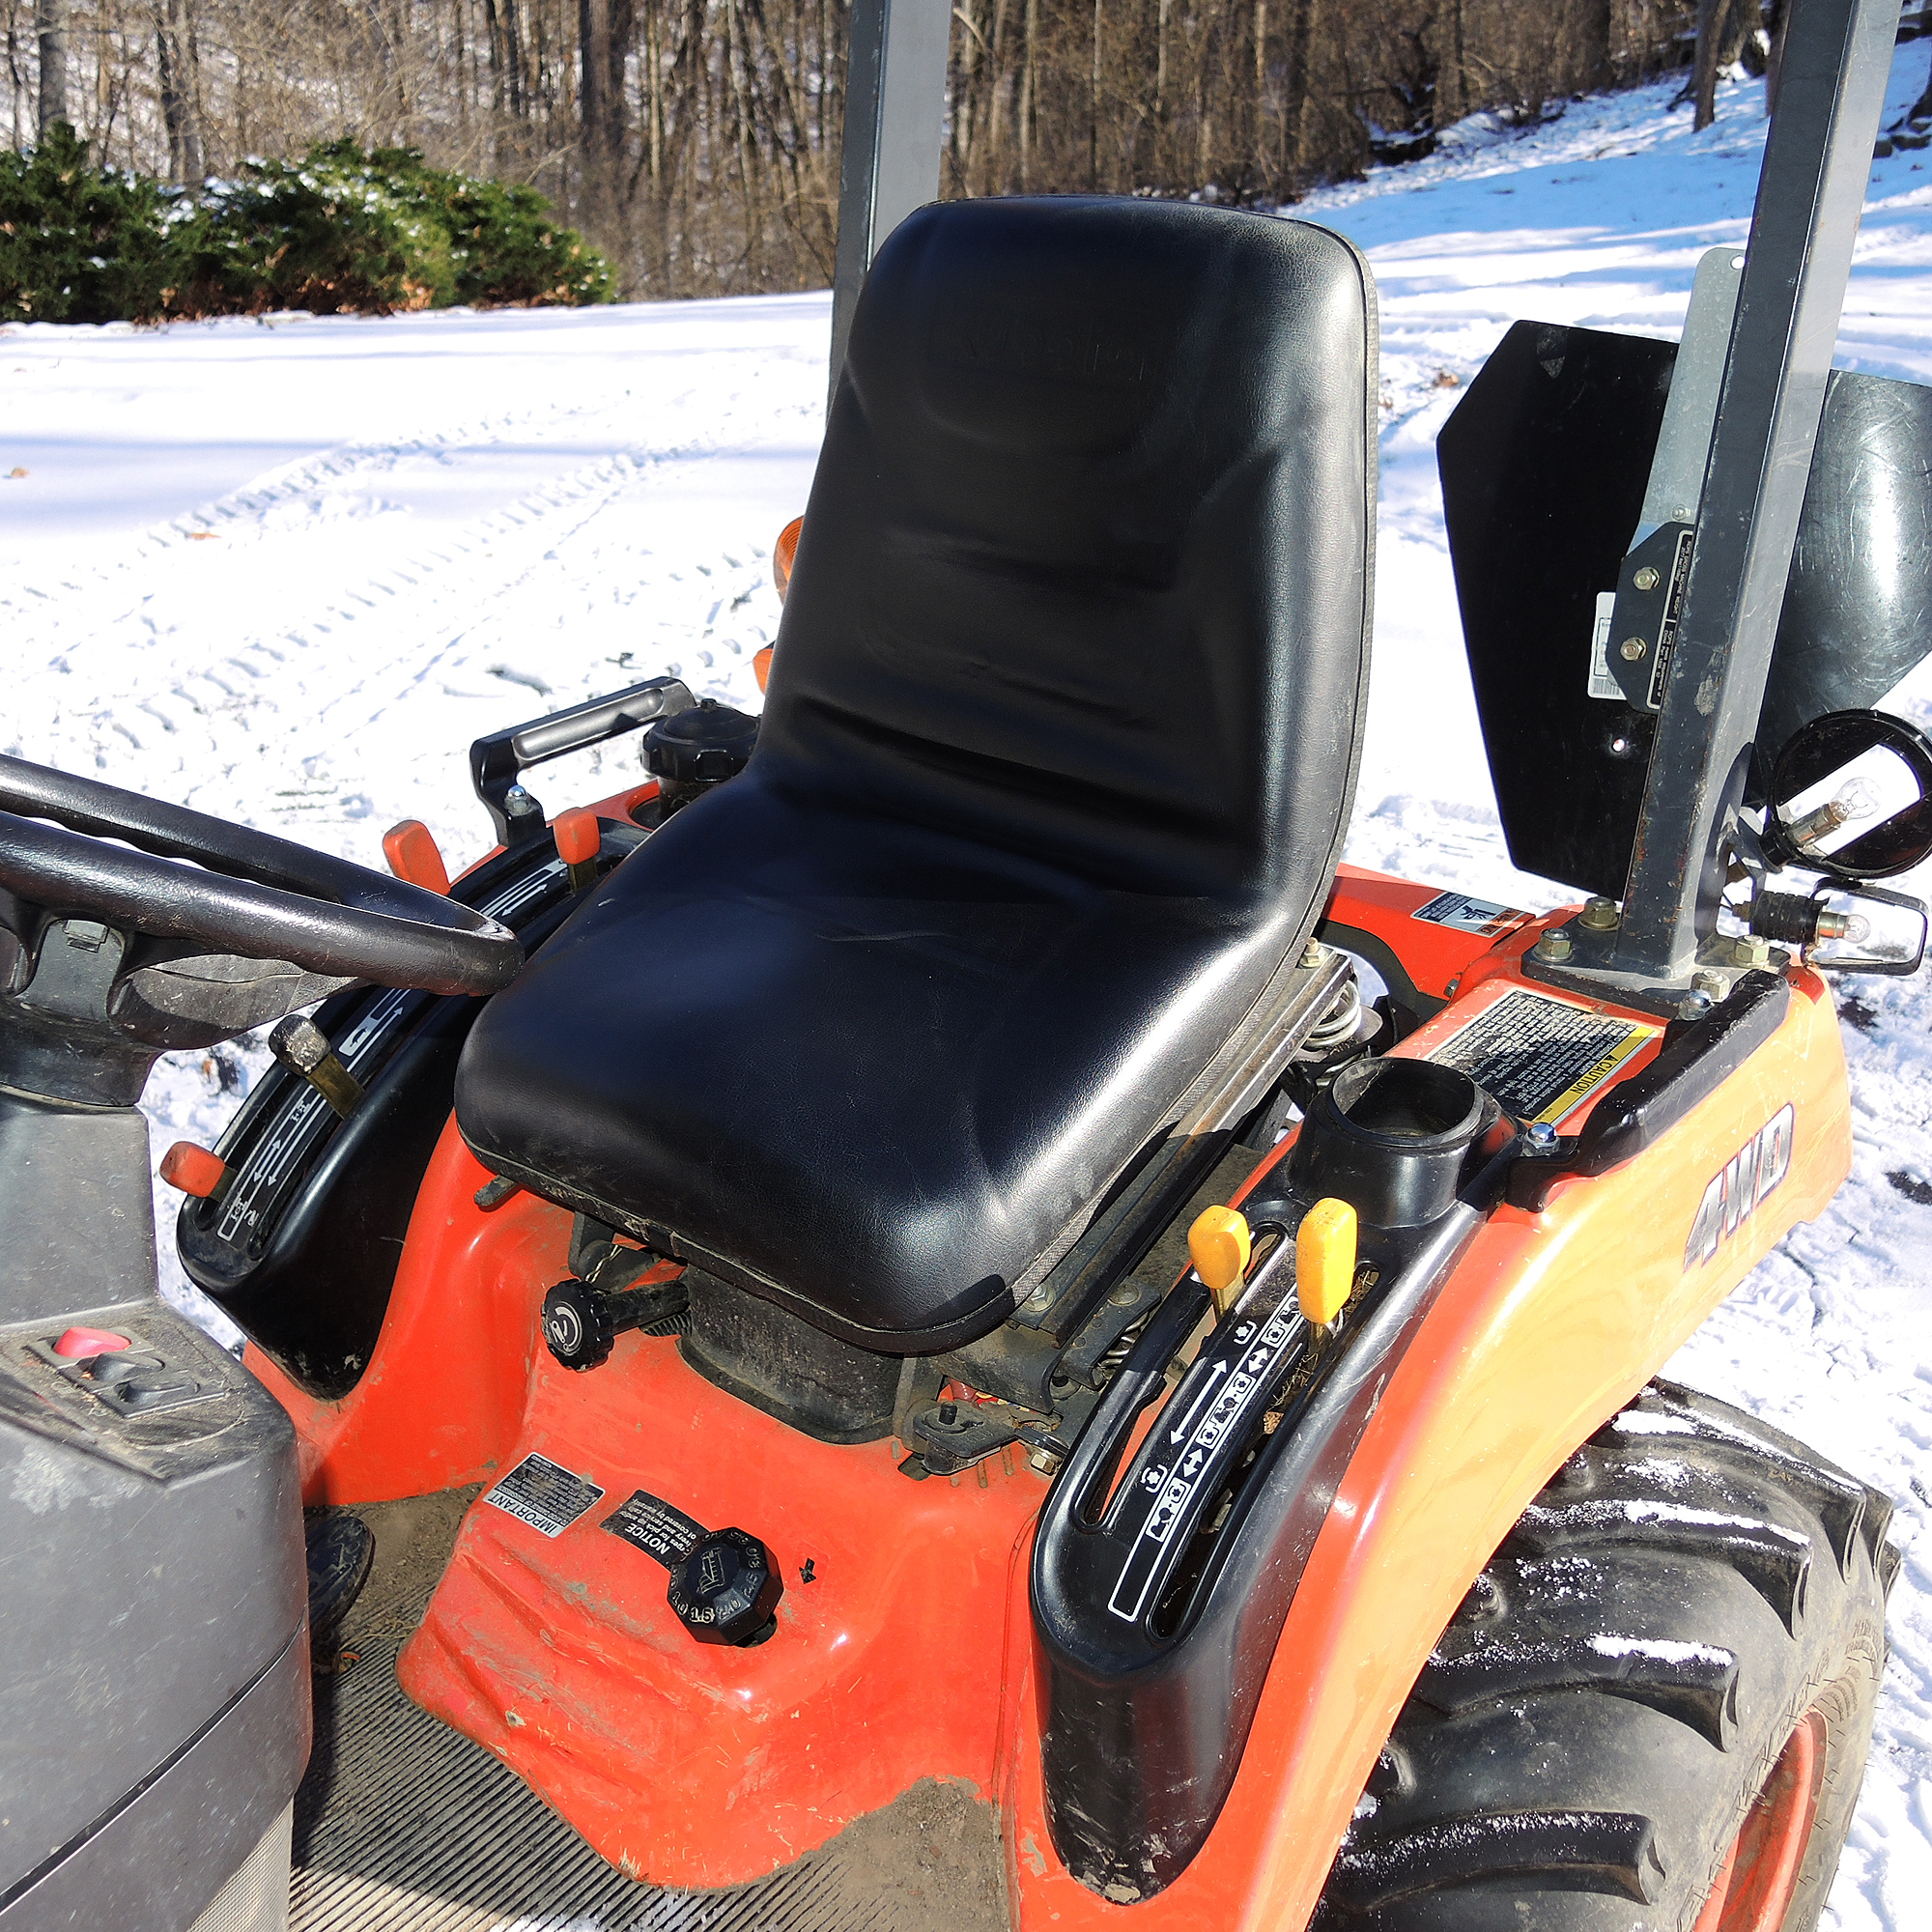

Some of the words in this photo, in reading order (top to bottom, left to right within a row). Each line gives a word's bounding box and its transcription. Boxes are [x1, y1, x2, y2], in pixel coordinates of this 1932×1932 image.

[1567, 1060, 1615, 1094] CAUTION
[1682, 1103, 1794, 1273] 4WD
[488, 1494, 558, 1534] IMPORTANT
[643, 1522, 661, 1535] pick
[661, 1523, 676, 1534] and
[663, 1516, 690, 1534] covered
[624, 1522, 670, 1555] NOTICE
[657, 1531, 670, 1541] for
[689, 1605, 714, 1623] 1.5
